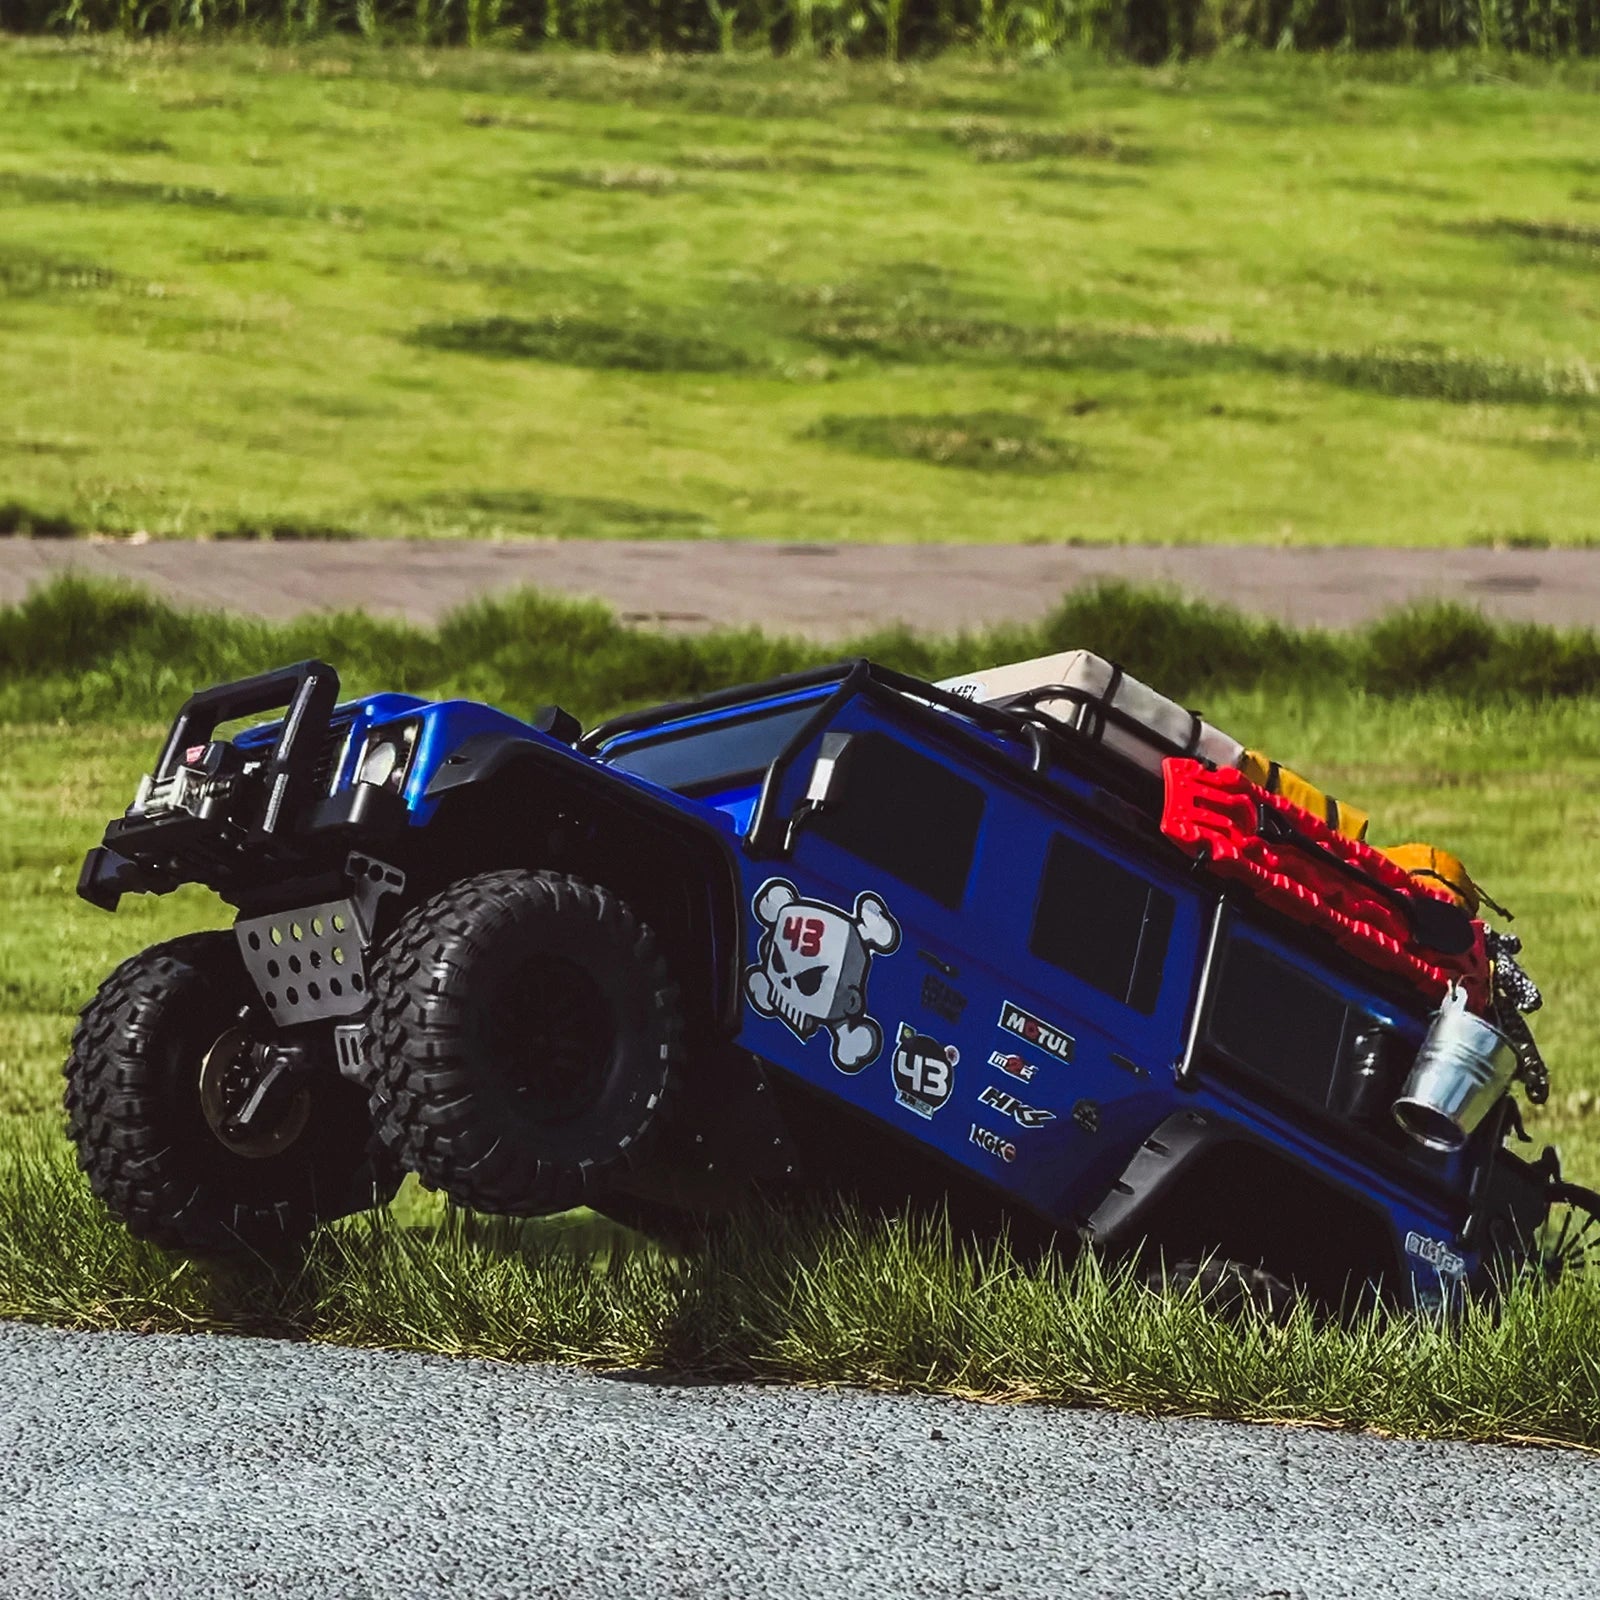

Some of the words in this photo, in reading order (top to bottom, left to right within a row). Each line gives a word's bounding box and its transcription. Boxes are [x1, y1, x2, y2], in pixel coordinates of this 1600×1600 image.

[782, 916, 825, 957] 43
[1006, 1012, 1068, 1057] MOTUL
[897, 1051, 948, 1097] 43
